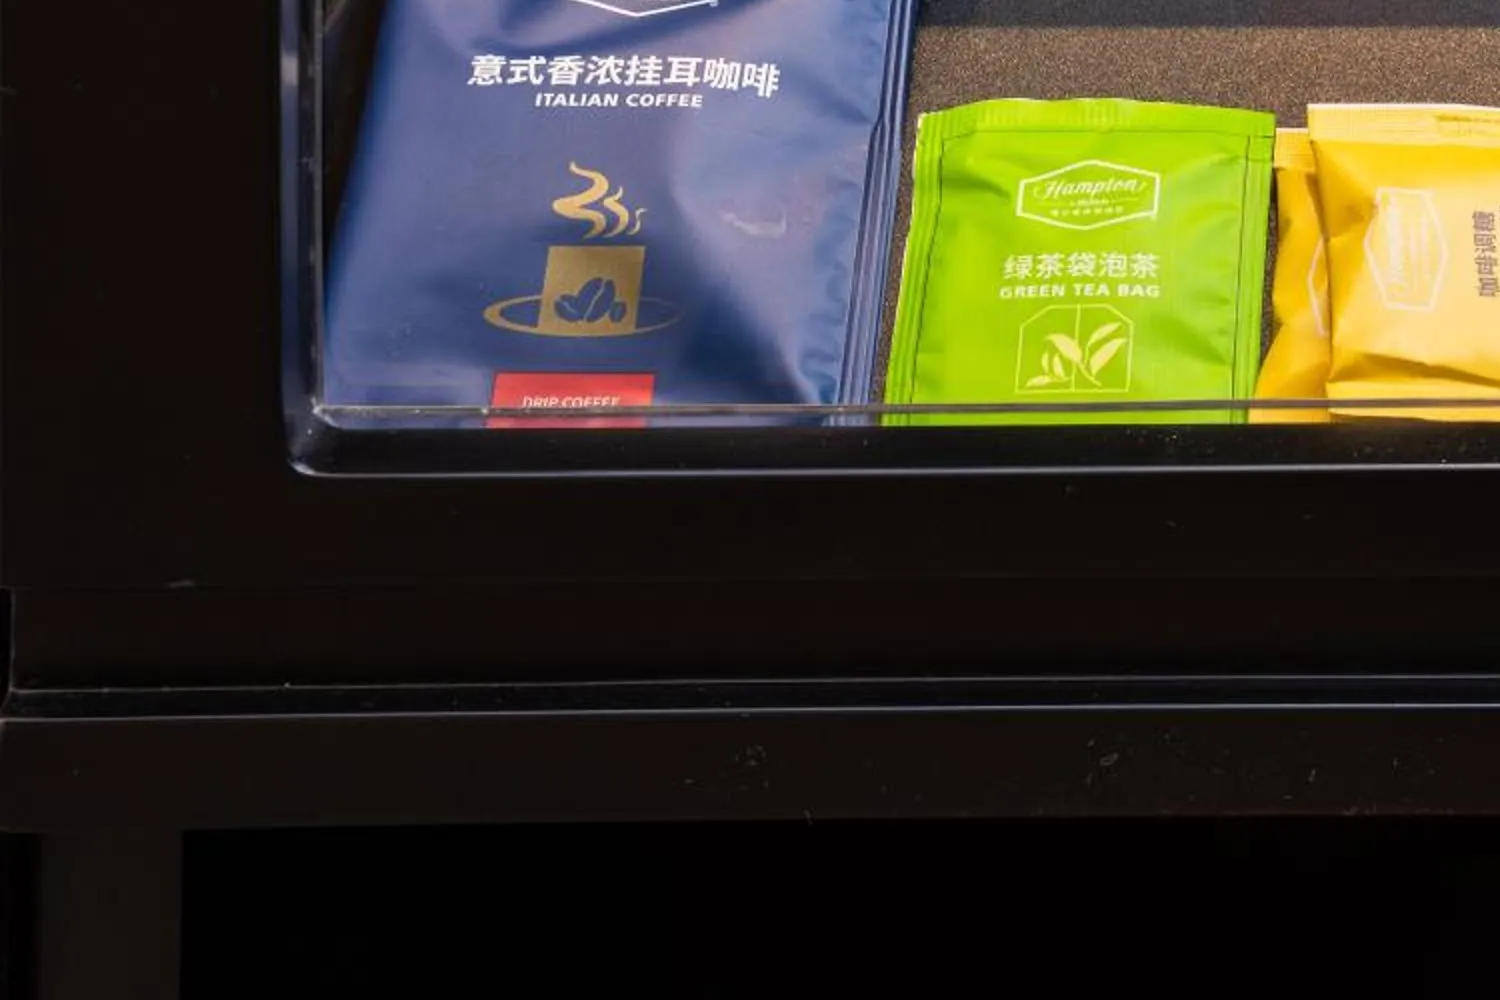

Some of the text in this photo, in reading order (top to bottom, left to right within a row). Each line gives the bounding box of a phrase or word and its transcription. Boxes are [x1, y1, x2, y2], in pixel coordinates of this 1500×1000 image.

[467, 54, 782, 98] 意式香浓挂耳咖啡
[535, 92, 703, 107] ITALIAN COFFEE
[1034, 177, 1148, 199] Hampton
[1003, 251, 1160, 279] 绿茶袋泡茶
[1000, 283, 1160, 299] GREEN TEA BAG
